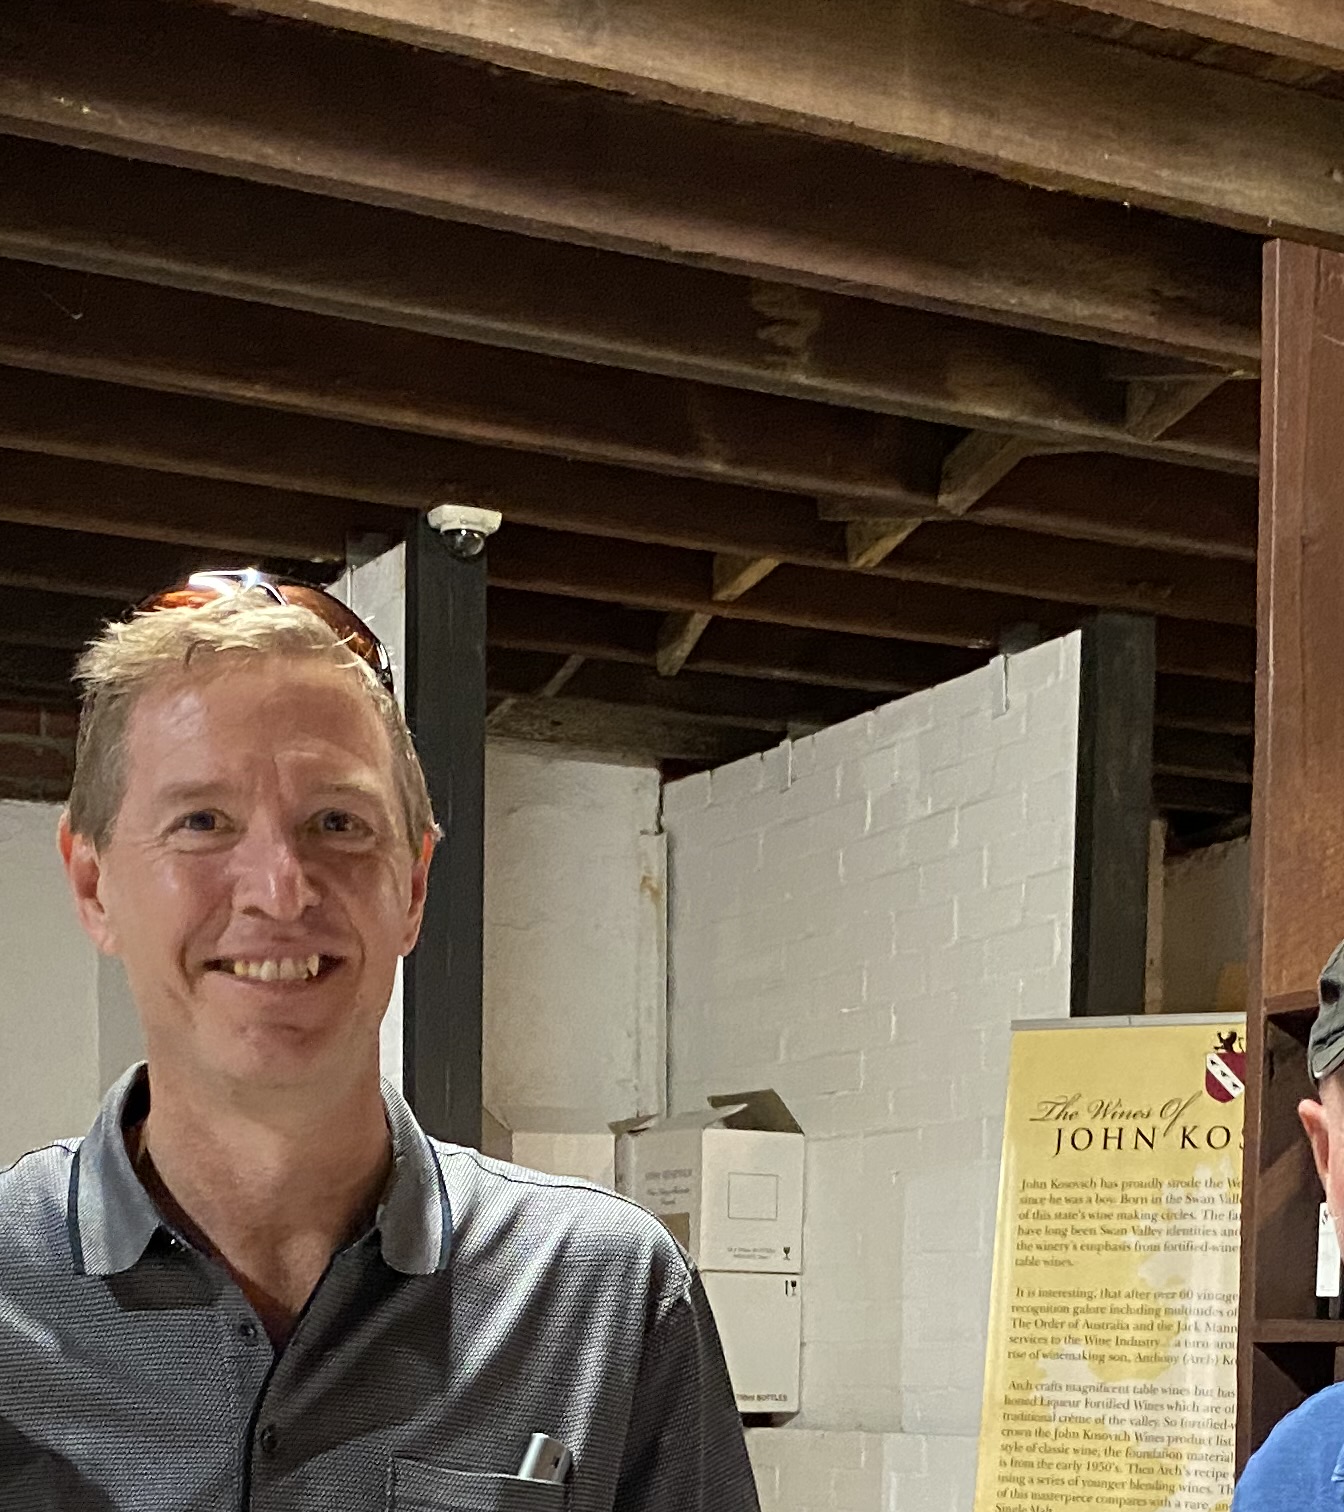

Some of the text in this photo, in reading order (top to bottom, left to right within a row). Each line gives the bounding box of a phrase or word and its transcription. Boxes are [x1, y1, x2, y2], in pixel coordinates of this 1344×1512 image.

[1029, 1090, 1203, 1138] The Wines Of
[1050, 1126, 1157, 1158] JOHN
[1022, 1178, 1047, 1192] John
[1050, 1178, 1097, 1189] Kosovich
[1100, 1178, 1118, 1189] has
[1121, 1178, 1163, 1192] proudly
[1205, 1177, 1223, 1189] the
[1120, 1194, 1215, 1205] Born in the Swan
[1018, 1208, 1225, 1223] of this state's wine making circles. The
[1100, 1225, 1216, 1237] Swan Valley identities
[1035, 1318, 1199, 1334] Order of Australia and the Jack
[1084, 1335, 1160, 1349] Wine Industry
[1056, 1461, 1082, 1473] early
[1081, 1476, 1175, 1494] younger blending
